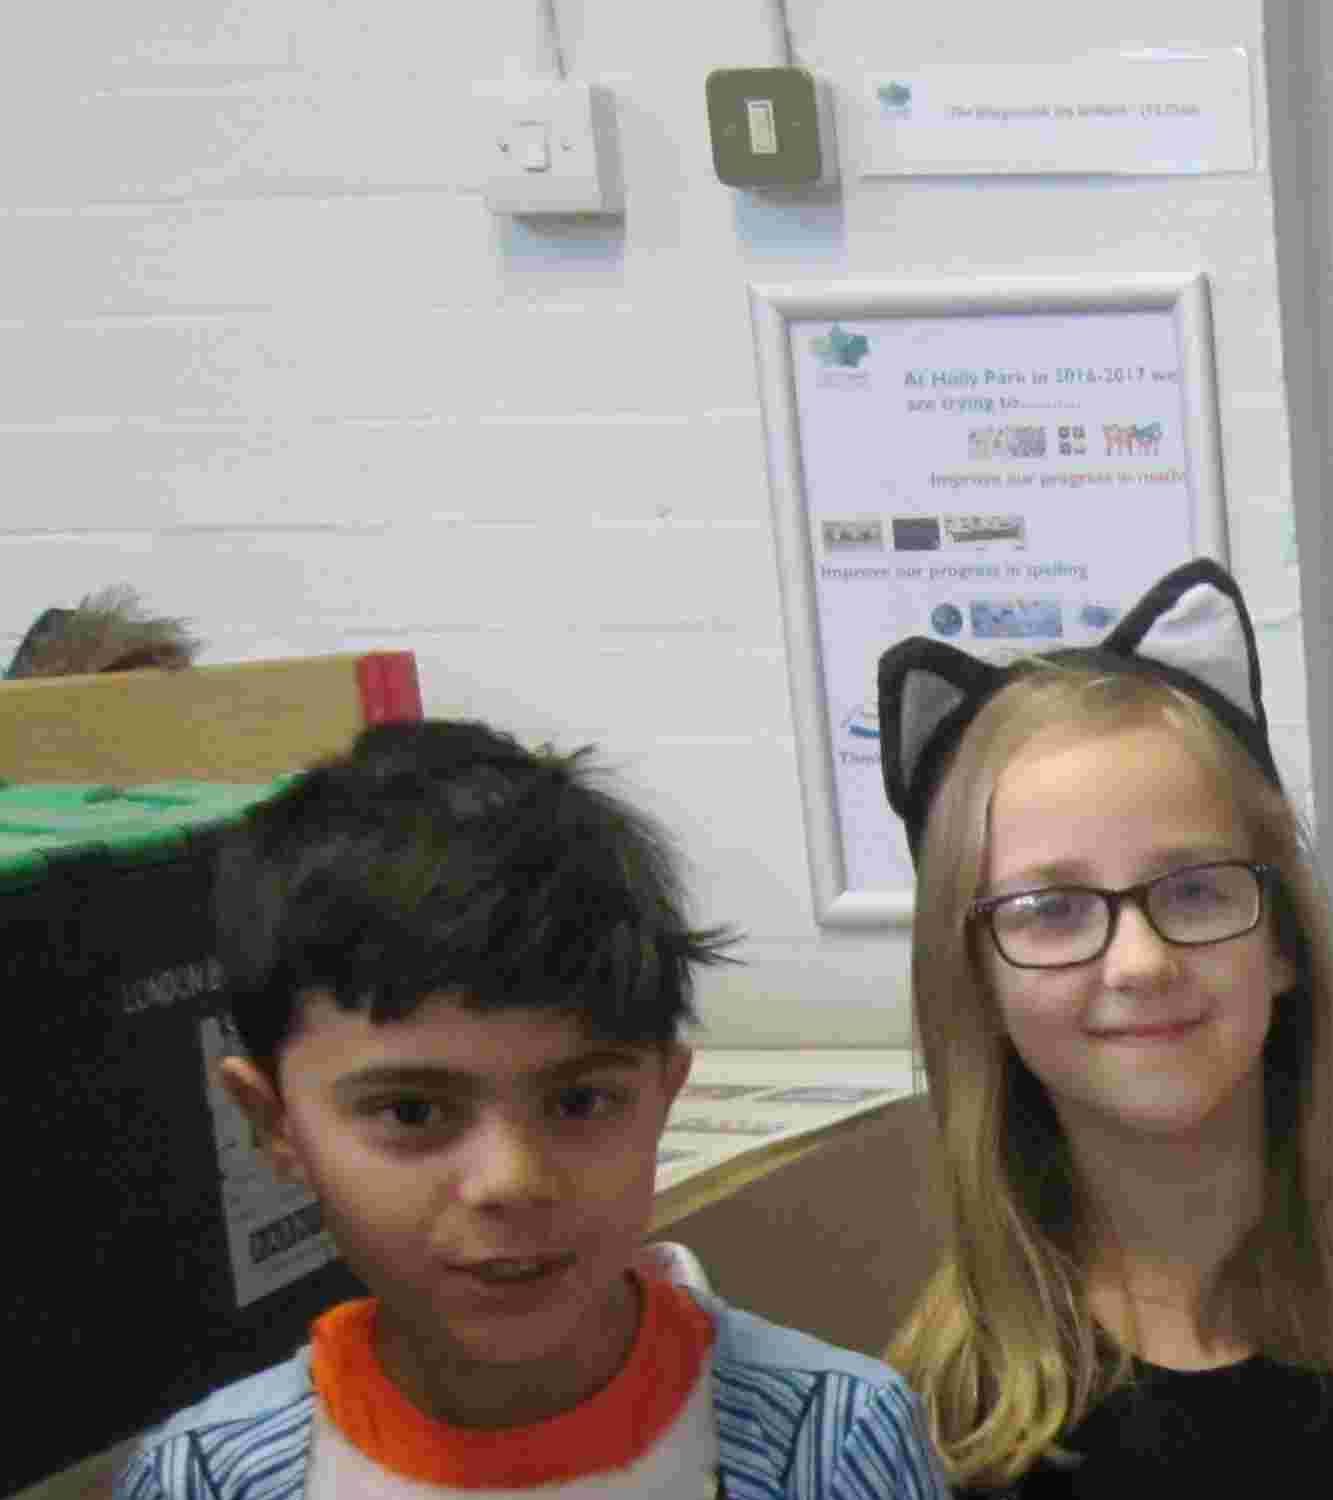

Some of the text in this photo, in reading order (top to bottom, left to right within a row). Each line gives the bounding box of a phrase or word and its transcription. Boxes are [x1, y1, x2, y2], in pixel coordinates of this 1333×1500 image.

[931, 368, 978, 390] Holly
[984, 368, 1026, 385] Park
[1032, 368, 1049, 385] in
[906, 397, 936, 413] are
[941, 396, 994, 415] trying
[820, 561, 1089, 583] Improve our progress in spelling
